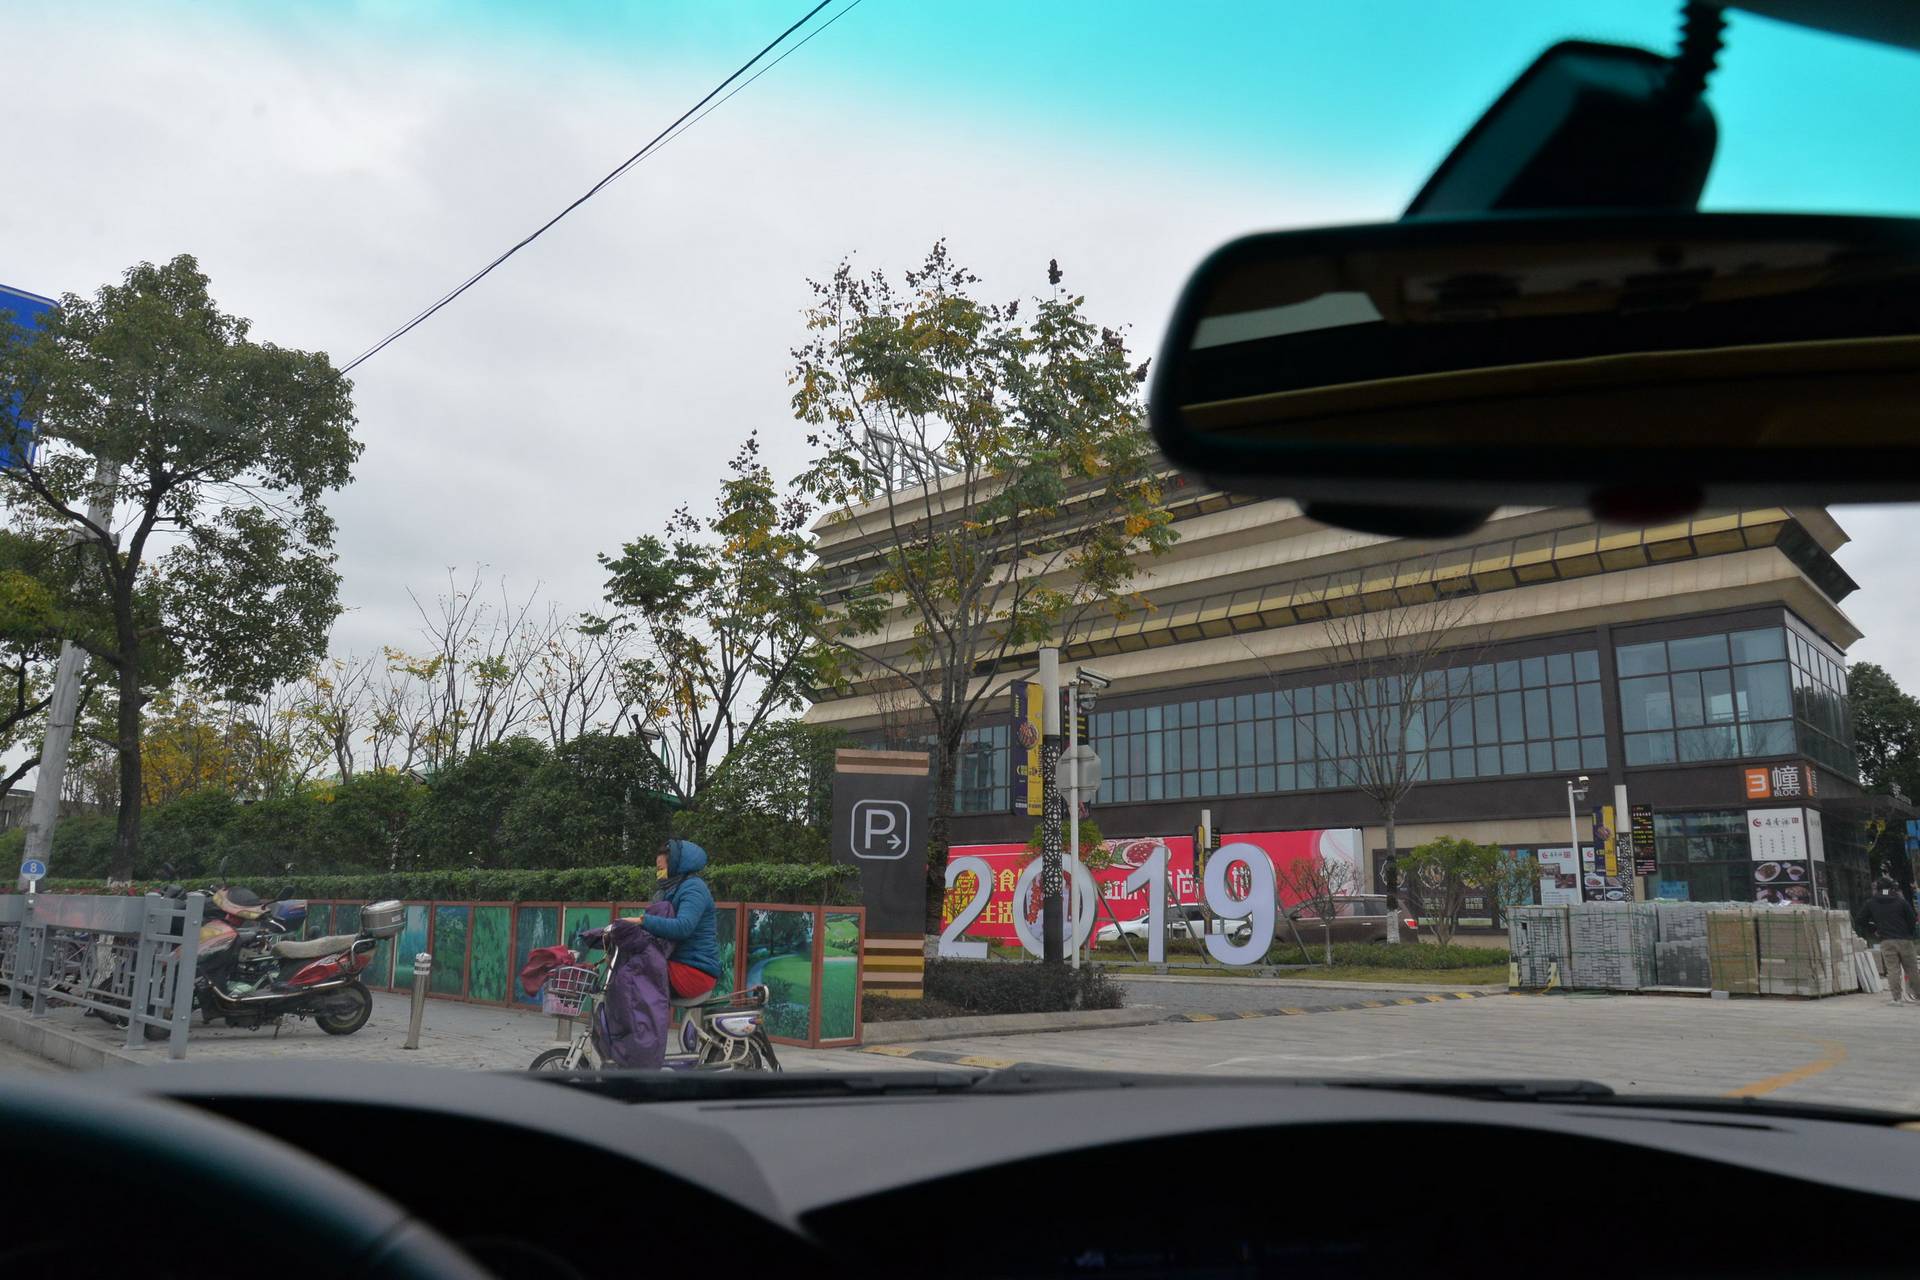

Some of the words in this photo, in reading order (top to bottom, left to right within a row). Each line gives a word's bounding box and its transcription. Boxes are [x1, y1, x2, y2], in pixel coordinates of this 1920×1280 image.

[1748, 774, 1767, 792] 3
[1774, 789, 1801, 797] BLOCK
[865, 809, 896, 849] P
[938, 842, 1277, 966] 2019
